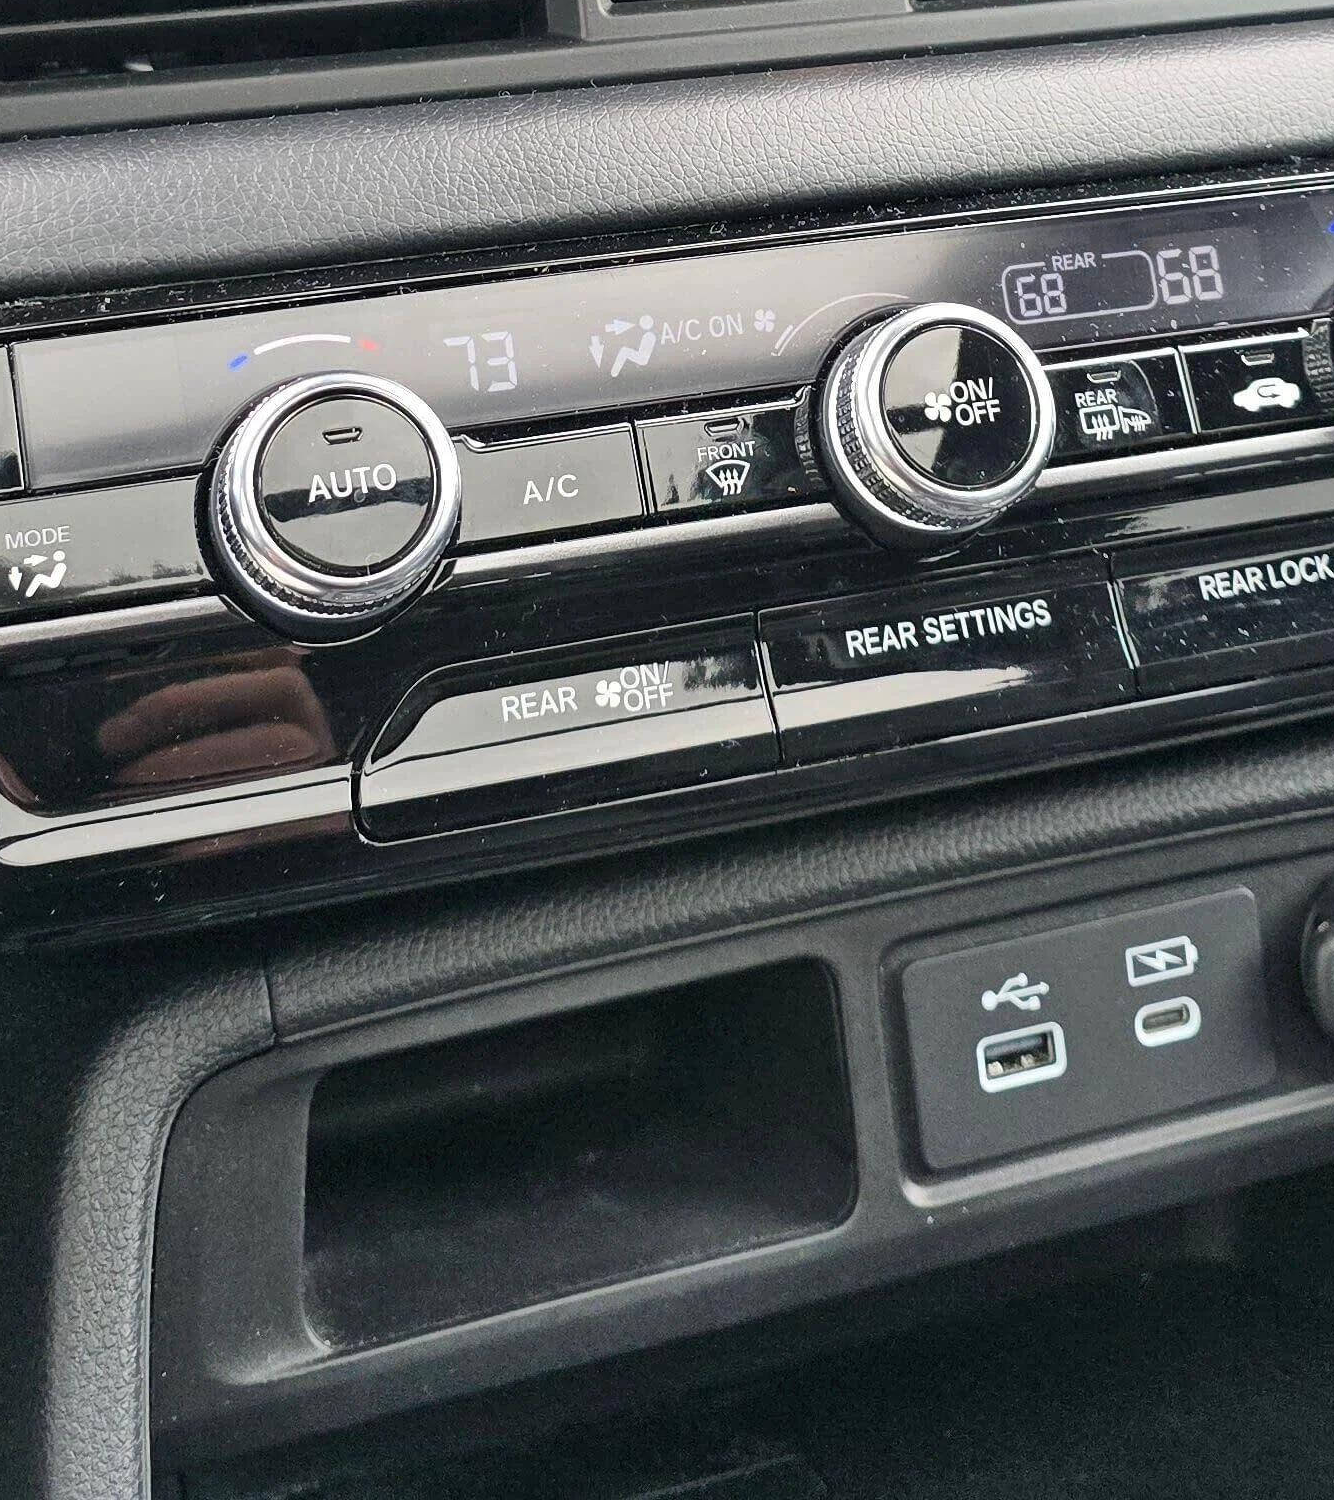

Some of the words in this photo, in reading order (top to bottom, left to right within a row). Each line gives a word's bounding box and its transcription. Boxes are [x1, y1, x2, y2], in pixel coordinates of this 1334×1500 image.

[1051, 251, 1097, 271] REAR
[1156, 245, 1224, 305] 68
[1016, 272, 1067, 317] 68
[660, 317, 703, 346] A/C
[708, 315, 744, 338] ON
[443, 331, 518, 393] 73
[950, 375, 995, 401] ON/
[1074, 388, 1119, 408] REAR
[954, 400, 1001, 426] OFF
[696, 439, 756, 461] FRONT
[307, 463, 398, 504] AUTO
[522, 474, 579, 506] A/C
[4, 525, 72, 550] MODE
[1198, 565, 1267, 602] REAR
[845, 620, 918, 658] REAR
[923, 599, 1053, 647] SETTINGS
[619, 661, 671, 690] ON/
[500, 687, 579, 722] REAR
[622, 683, 674, 714] OFF
